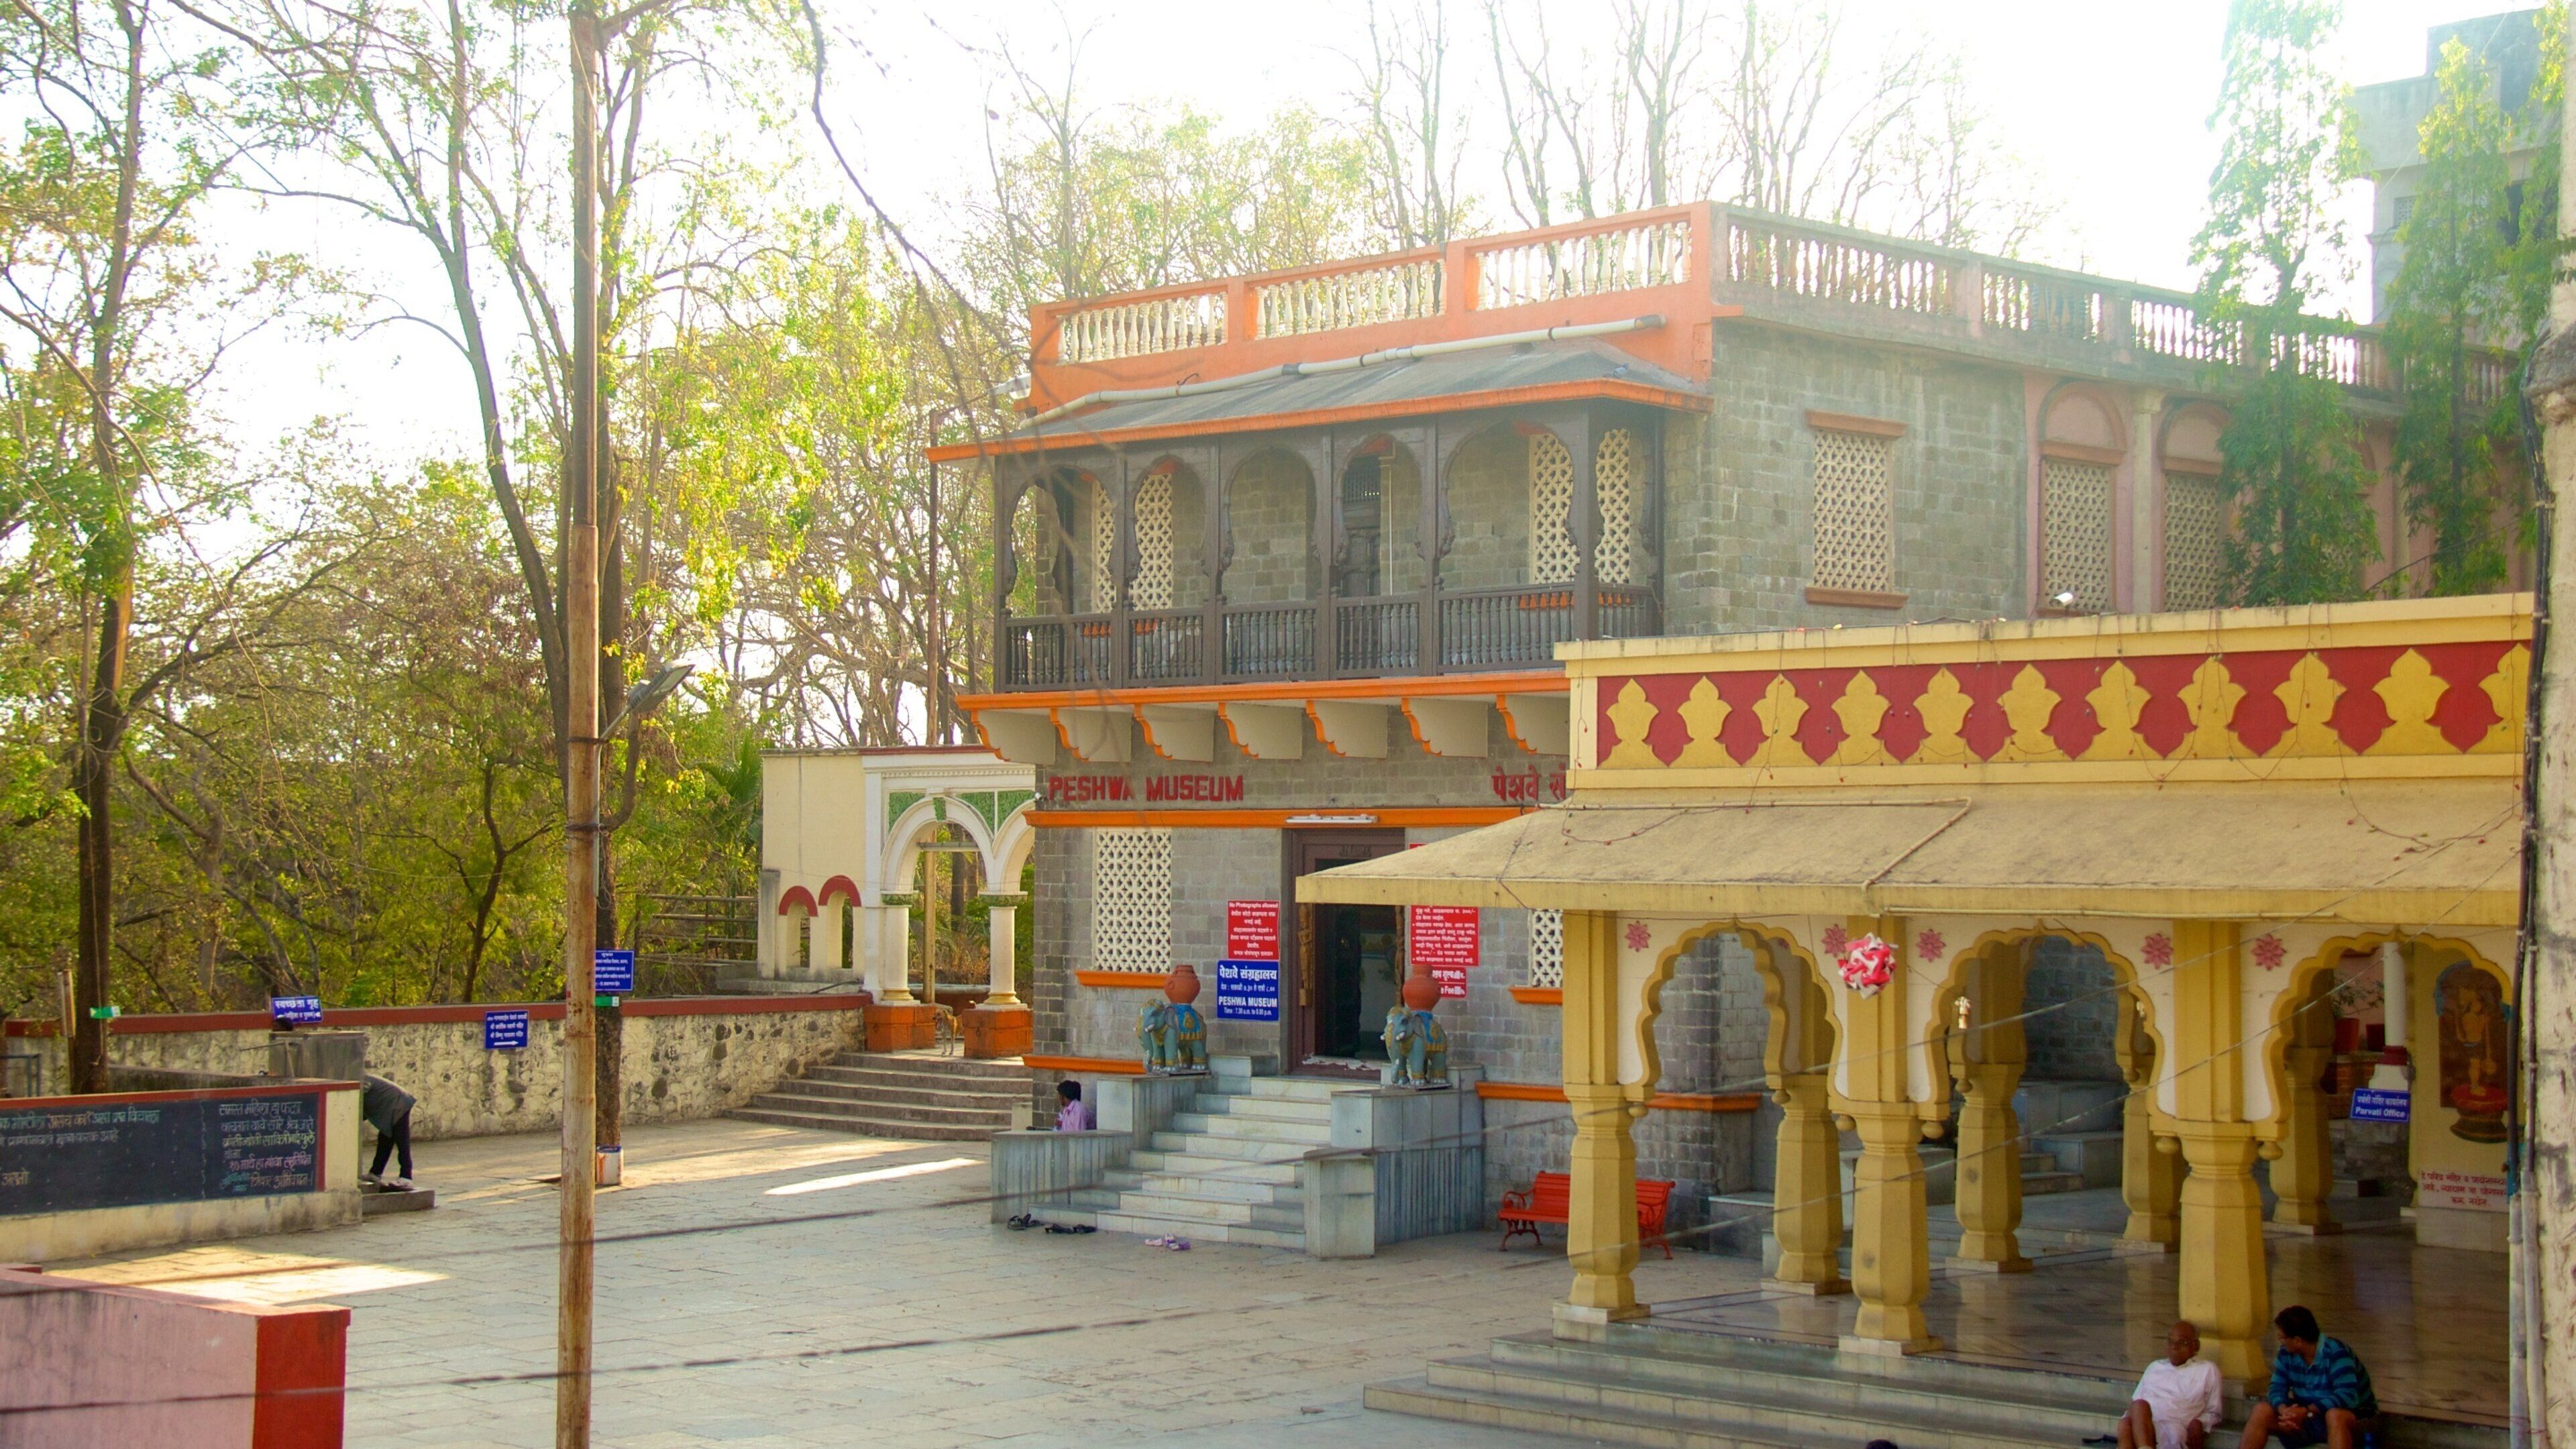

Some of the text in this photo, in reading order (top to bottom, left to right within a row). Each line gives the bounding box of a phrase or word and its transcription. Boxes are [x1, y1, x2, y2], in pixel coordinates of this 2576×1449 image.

[1049, 775, 1244, 802] PESHWA MUSEUM
[1492, 765, 1542, 801] पेशवे
[1220, 965, 1277, 981] पेशवे संग्रहालय
[274, 1000, 319, 1010] स्वच्छता गृह
[1219, 996, 1277, 1008] PESHWA MUSEUM
[2356, 1107, 2405, 1118] Parvati Office
